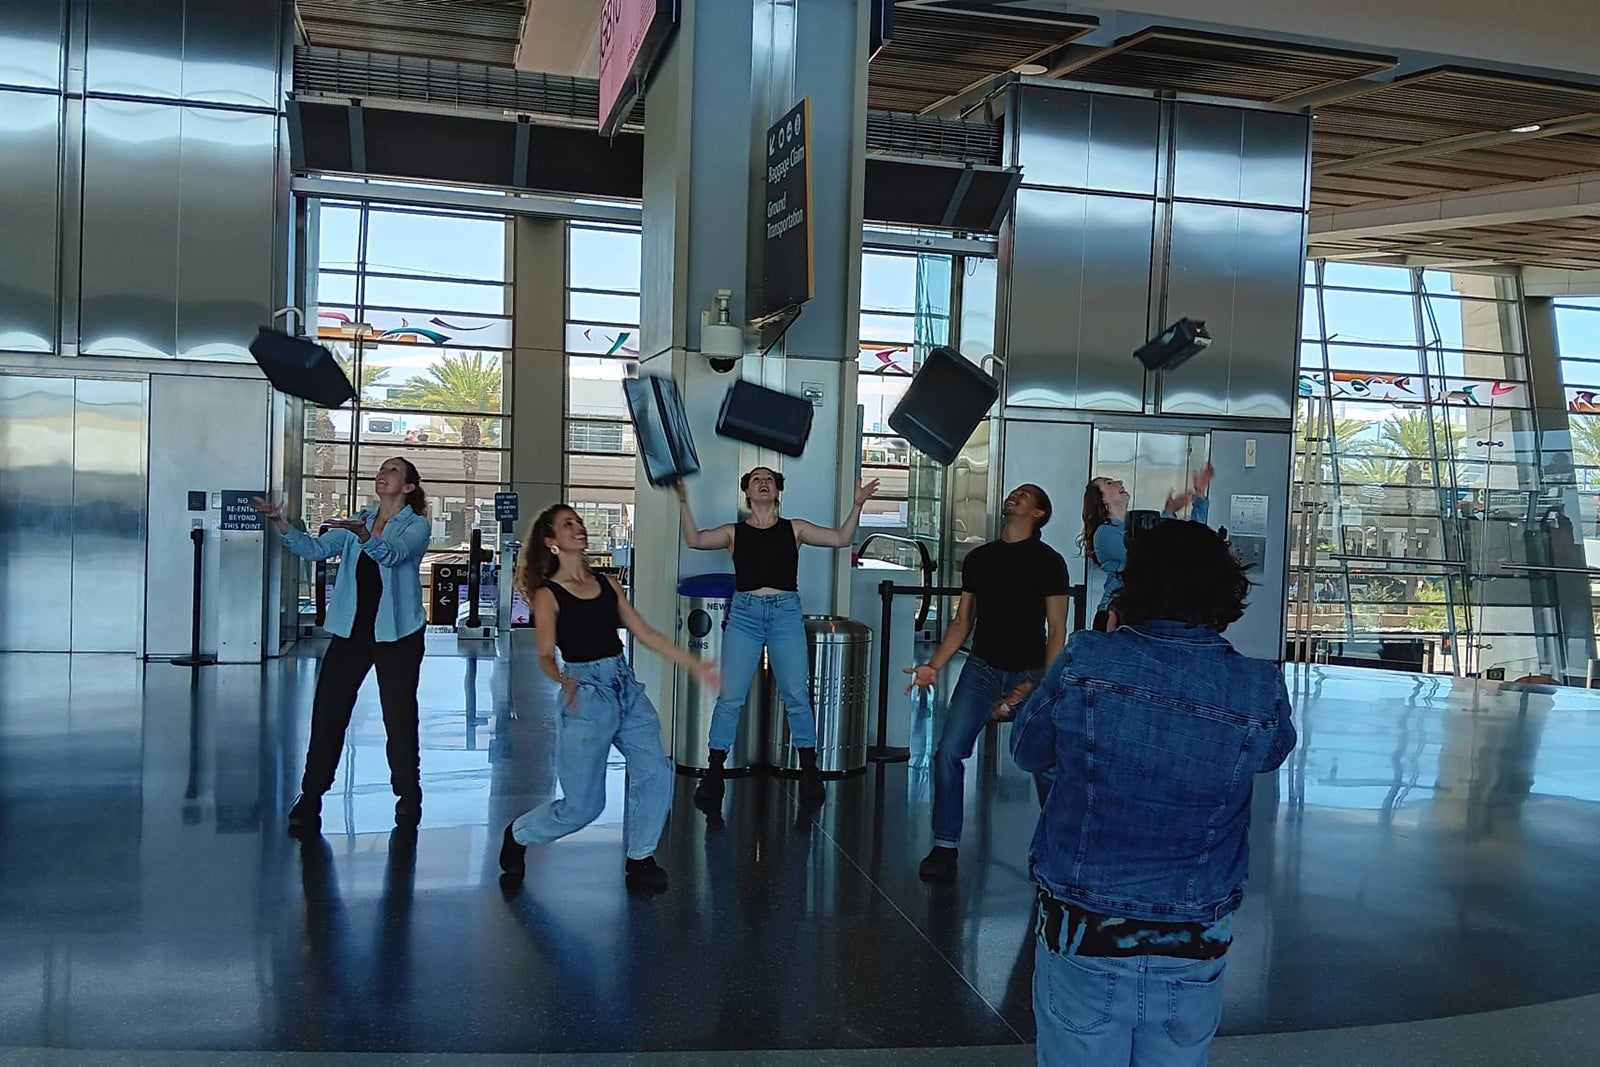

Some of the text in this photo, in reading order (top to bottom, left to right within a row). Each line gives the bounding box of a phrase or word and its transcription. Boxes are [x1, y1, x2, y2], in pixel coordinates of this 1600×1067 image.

[768, 145, 805, 184] Baggage Claim
[767, 191, 787, 218] Ground
[767, 207, 804, 239] Transportation
[437, 582, 454, 593] 1-3
[687, 640, 709, 650] CANS
